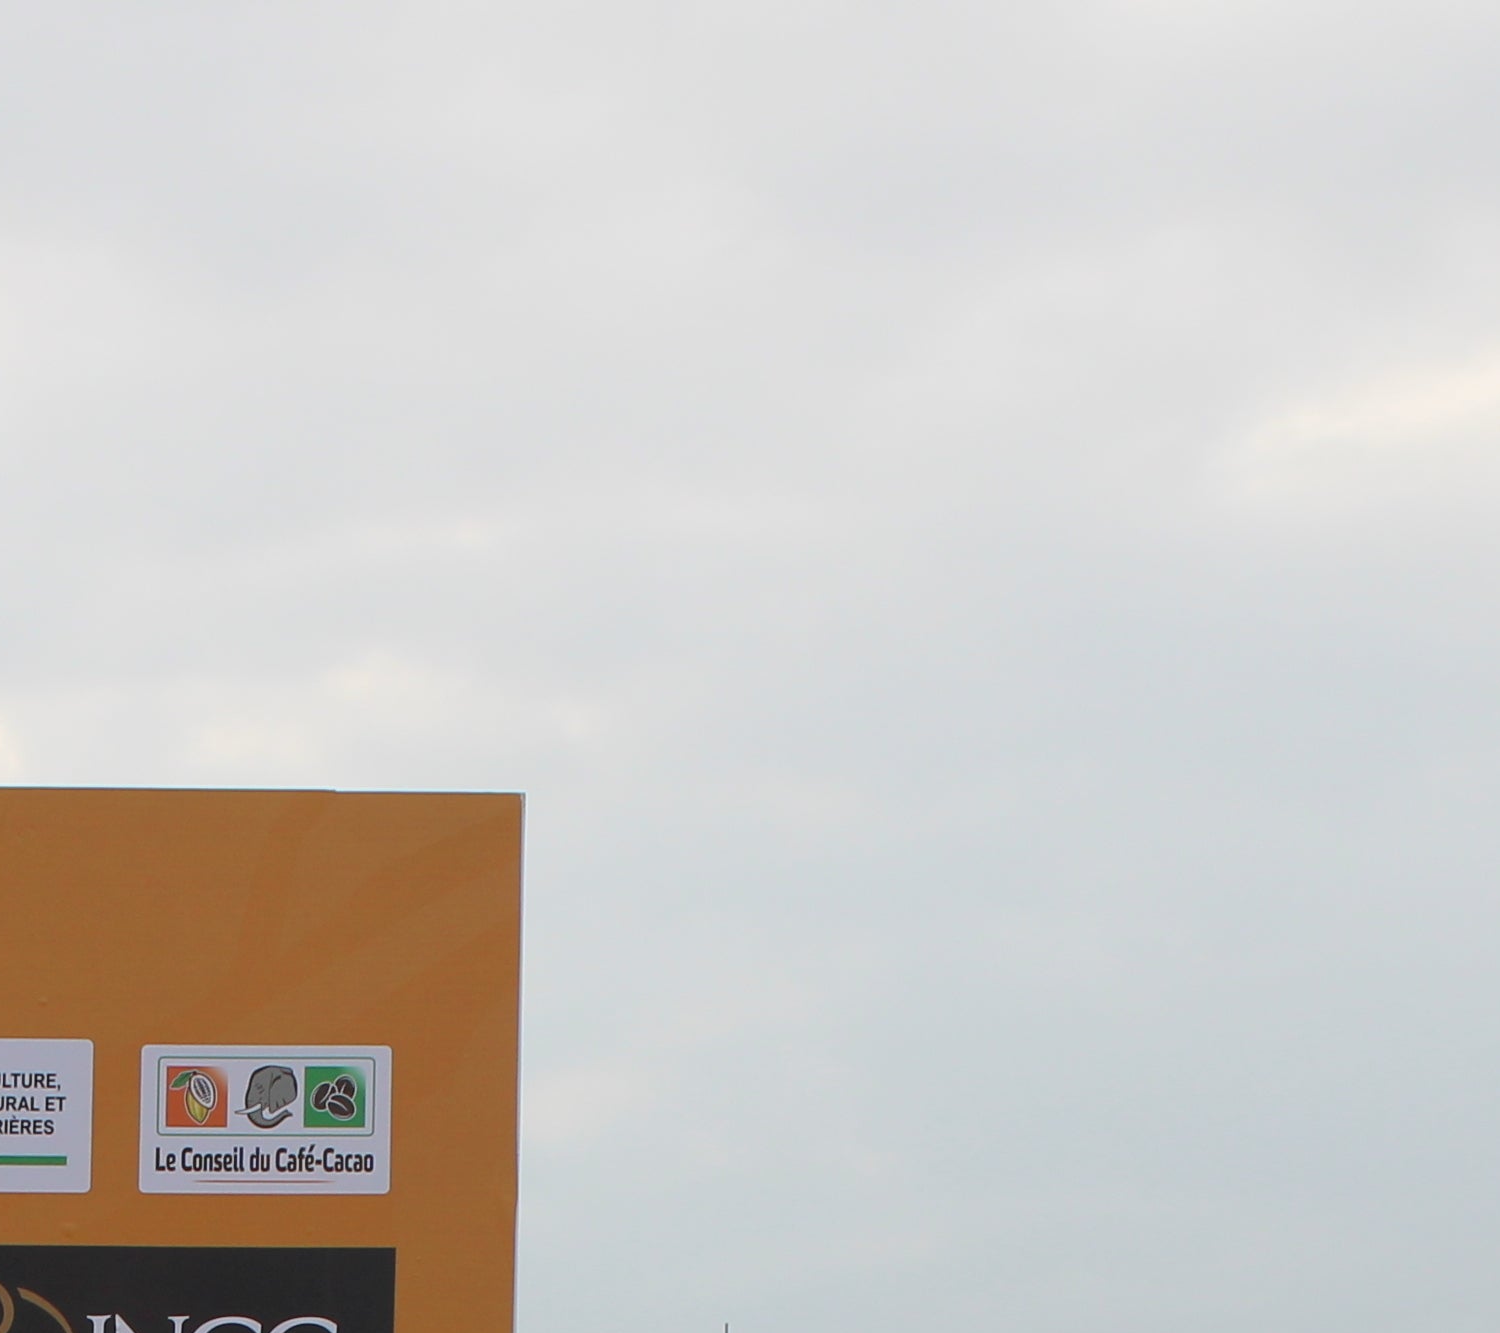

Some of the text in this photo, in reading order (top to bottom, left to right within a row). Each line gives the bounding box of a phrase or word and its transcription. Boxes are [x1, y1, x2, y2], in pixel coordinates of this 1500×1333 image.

[45, 1096, 67, 1112] ET
[155, 1144, 374, 1173] Le Conseil du Café-Cacao
